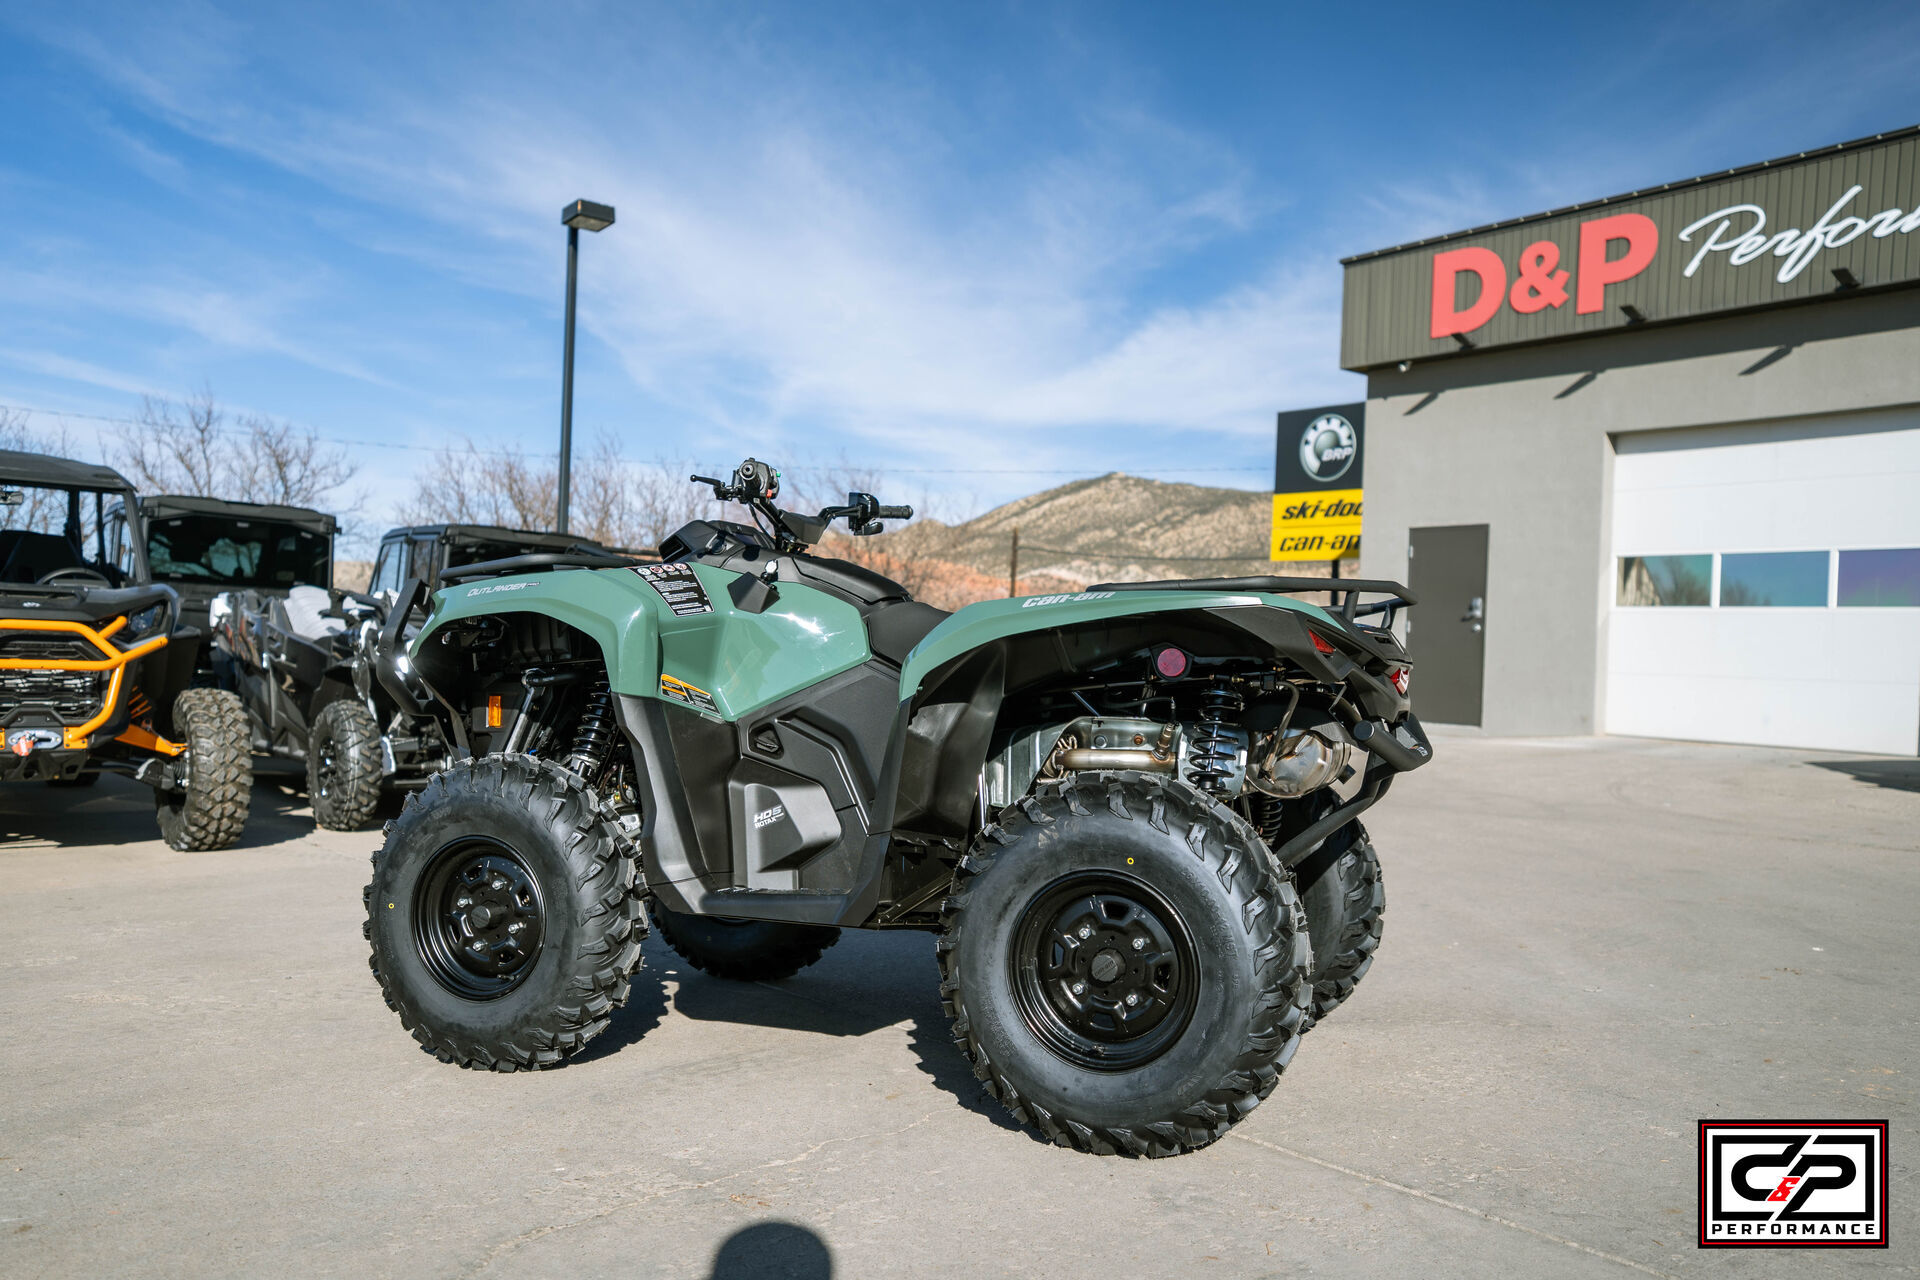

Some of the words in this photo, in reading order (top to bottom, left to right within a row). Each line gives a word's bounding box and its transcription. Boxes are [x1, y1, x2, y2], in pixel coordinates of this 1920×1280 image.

[1430, 212, 1659, 339] D&P
[1321, 447, 1354, 462] BRP
[467, 582, 527, 597] OUTLANDER
[1022, 591, 1116, 608] can-am
[754, 816, 777, 829] ROTAX
